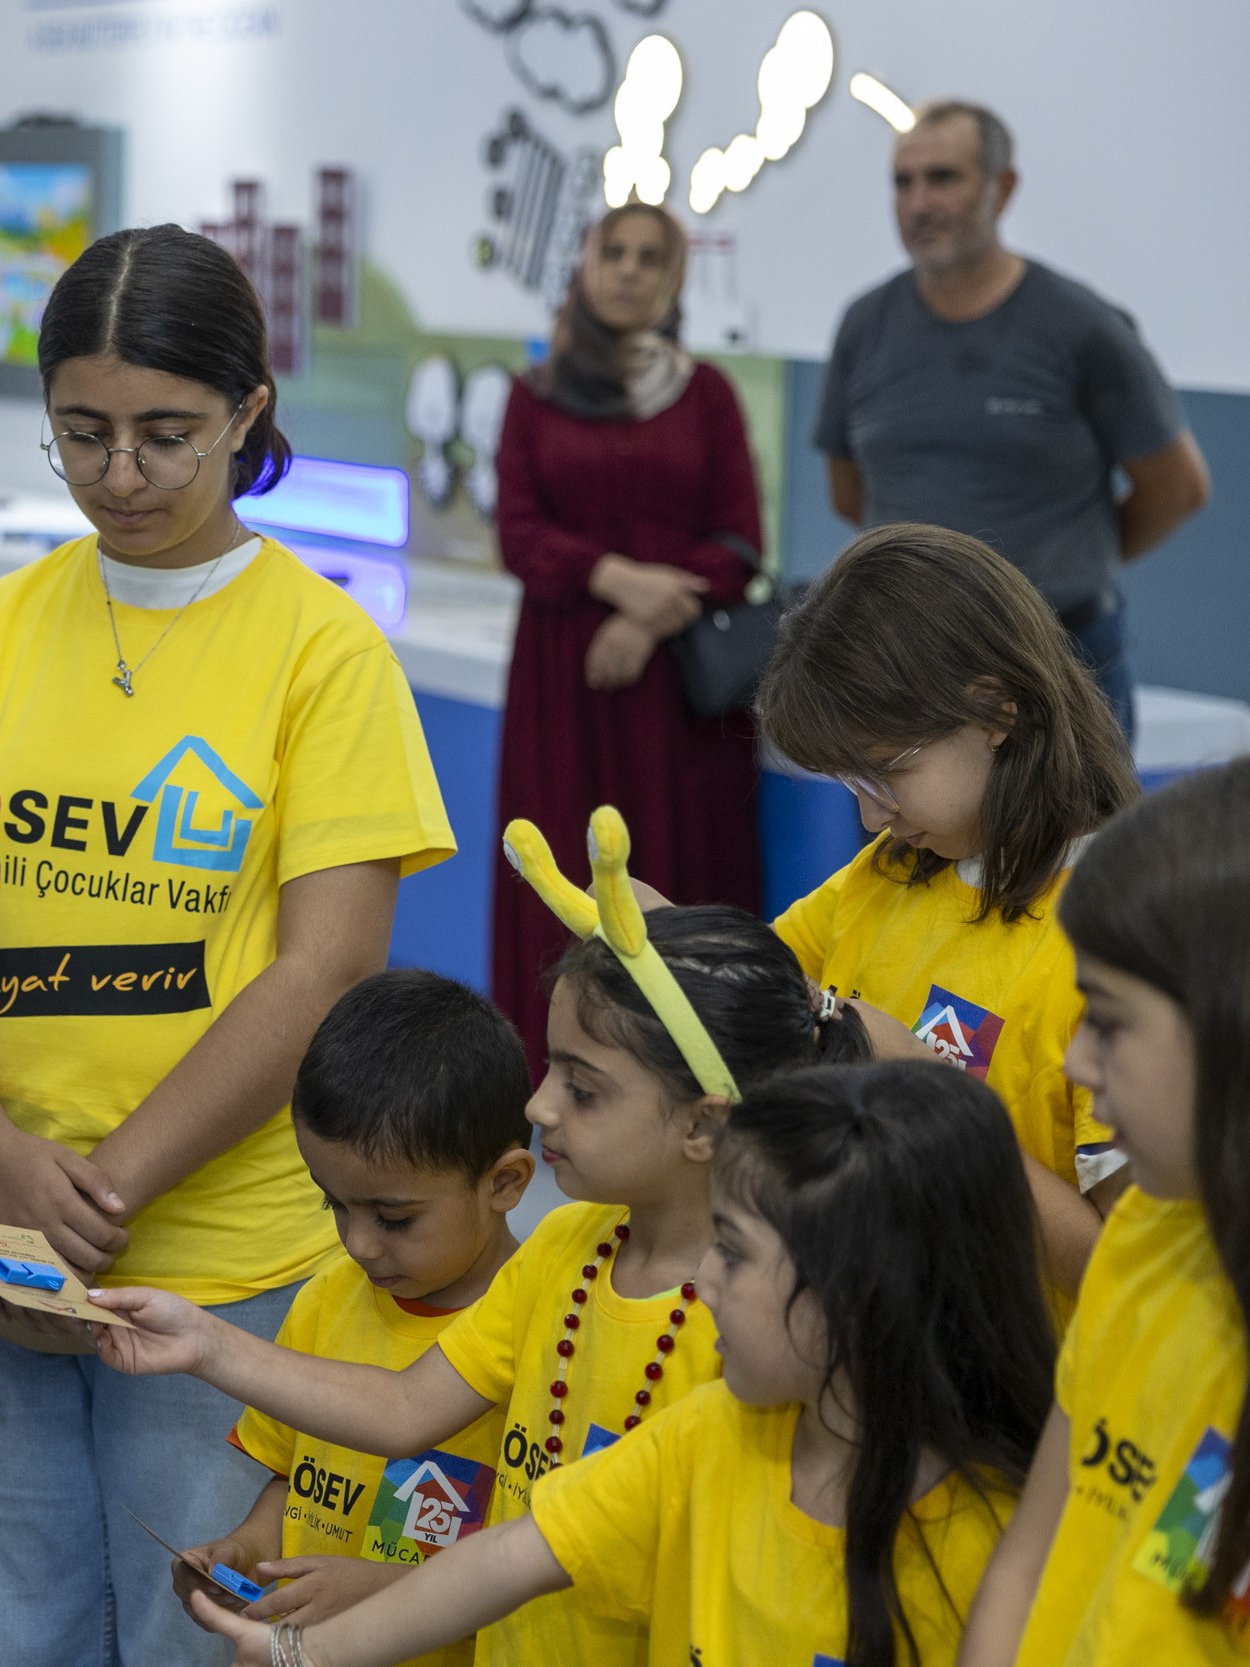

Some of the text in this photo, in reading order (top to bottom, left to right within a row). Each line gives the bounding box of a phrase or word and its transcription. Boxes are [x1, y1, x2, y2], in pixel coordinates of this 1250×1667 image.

[36, 860, 160, 906] Çocuklar
[90, 966, 198, 992] verir
[288, 1455, 367, 1517] ÖSEV
[325, 1522, 354, 1544] UMUT
[416, 1497, 451, 1533] 25
